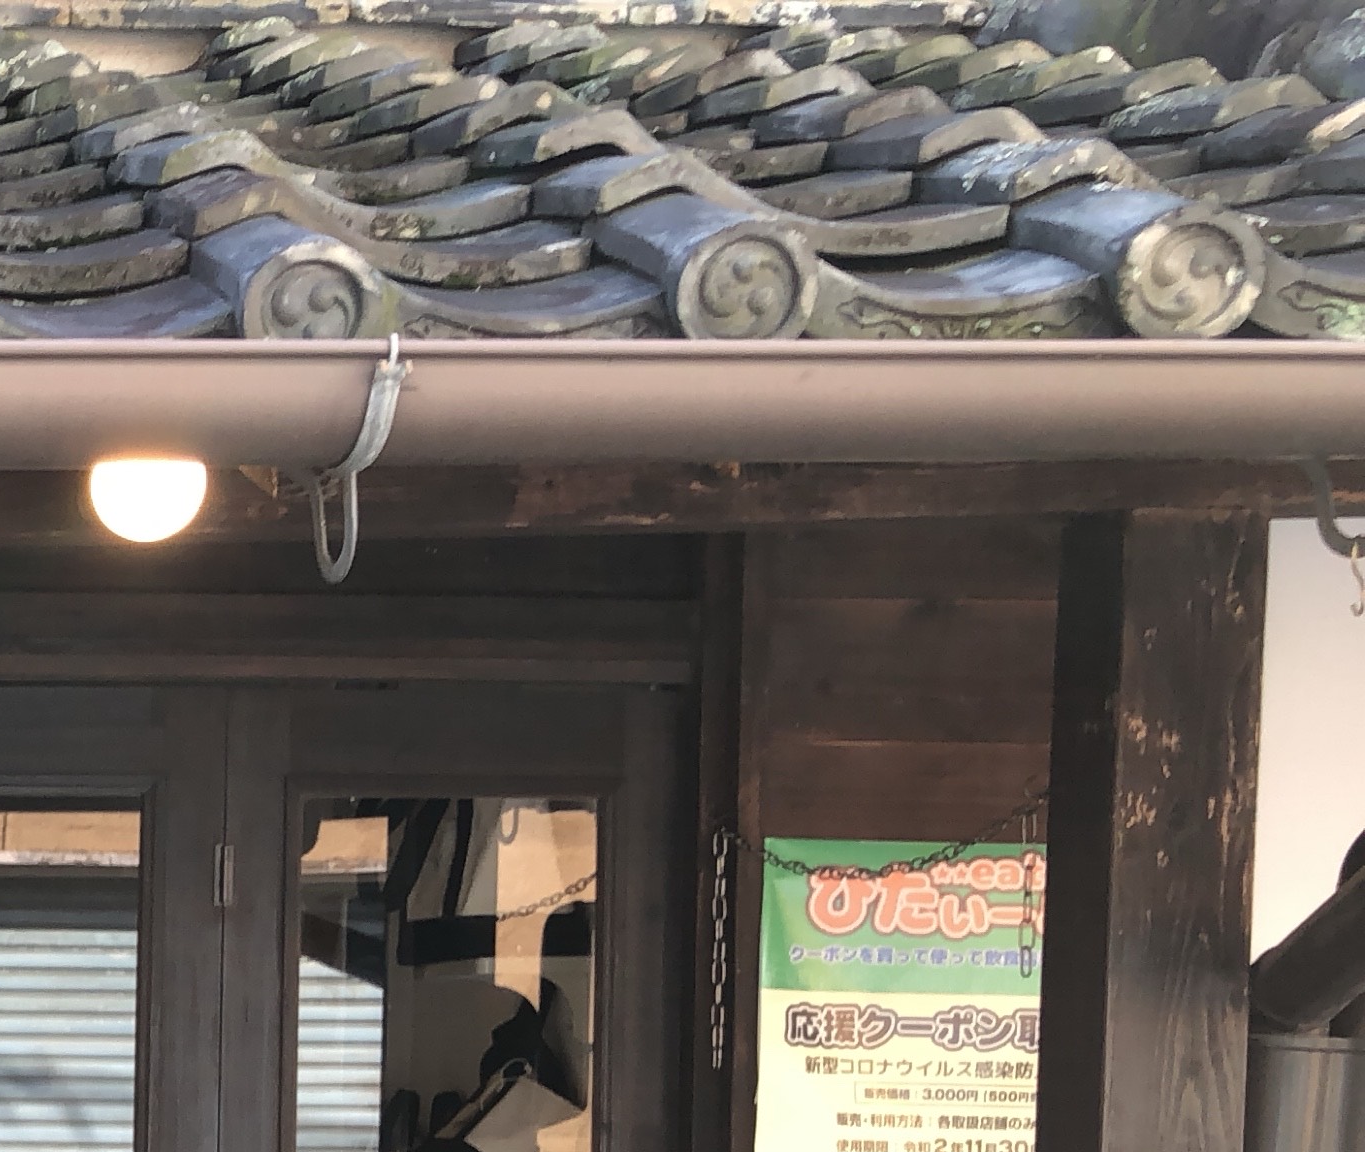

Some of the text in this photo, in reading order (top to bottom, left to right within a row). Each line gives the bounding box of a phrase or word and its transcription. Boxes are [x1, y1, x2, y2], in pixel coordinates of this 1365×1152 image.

[805, 1056, 1037, 1080] 新型コロナウイルス感染防
